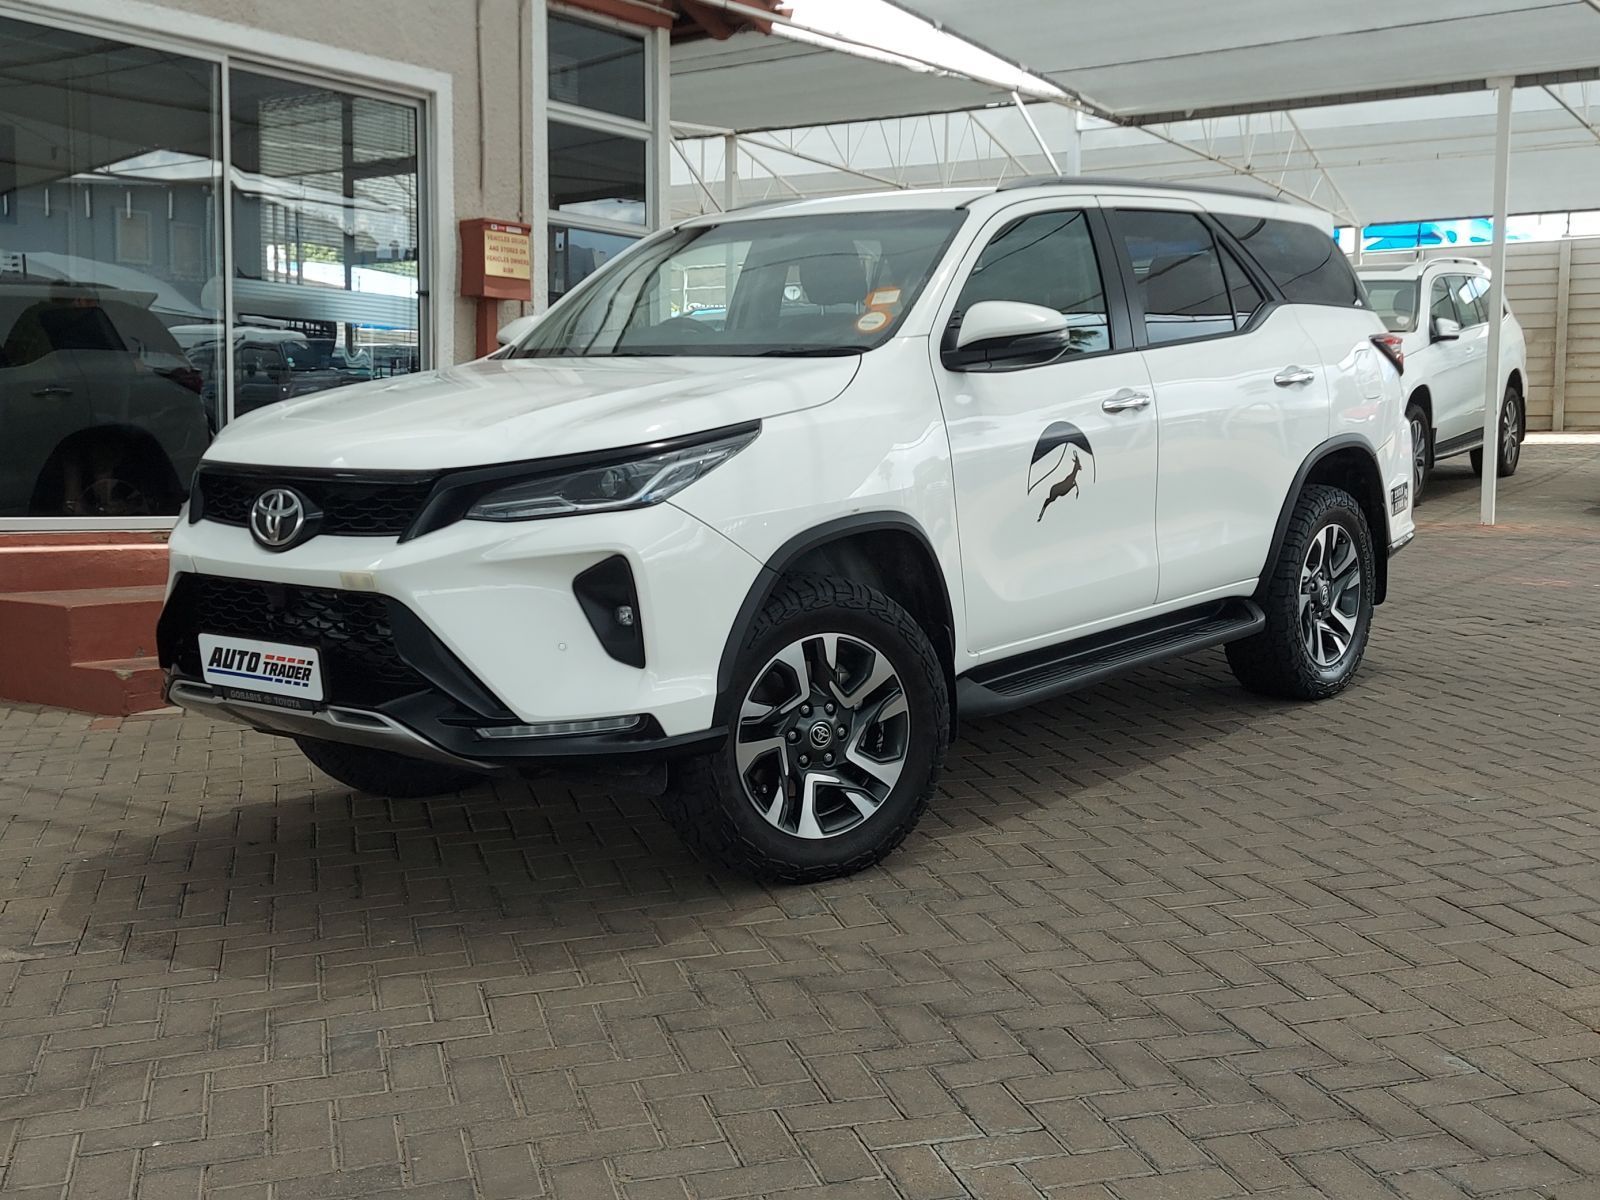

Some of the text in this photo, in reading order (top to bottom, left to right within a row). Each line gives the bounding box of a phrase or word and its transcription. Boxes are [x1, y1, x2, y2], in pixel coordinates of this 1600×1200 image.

[208, 646, 312, 682] AUTO TRADER
[273, 696, 302, 709] TOYOTA
